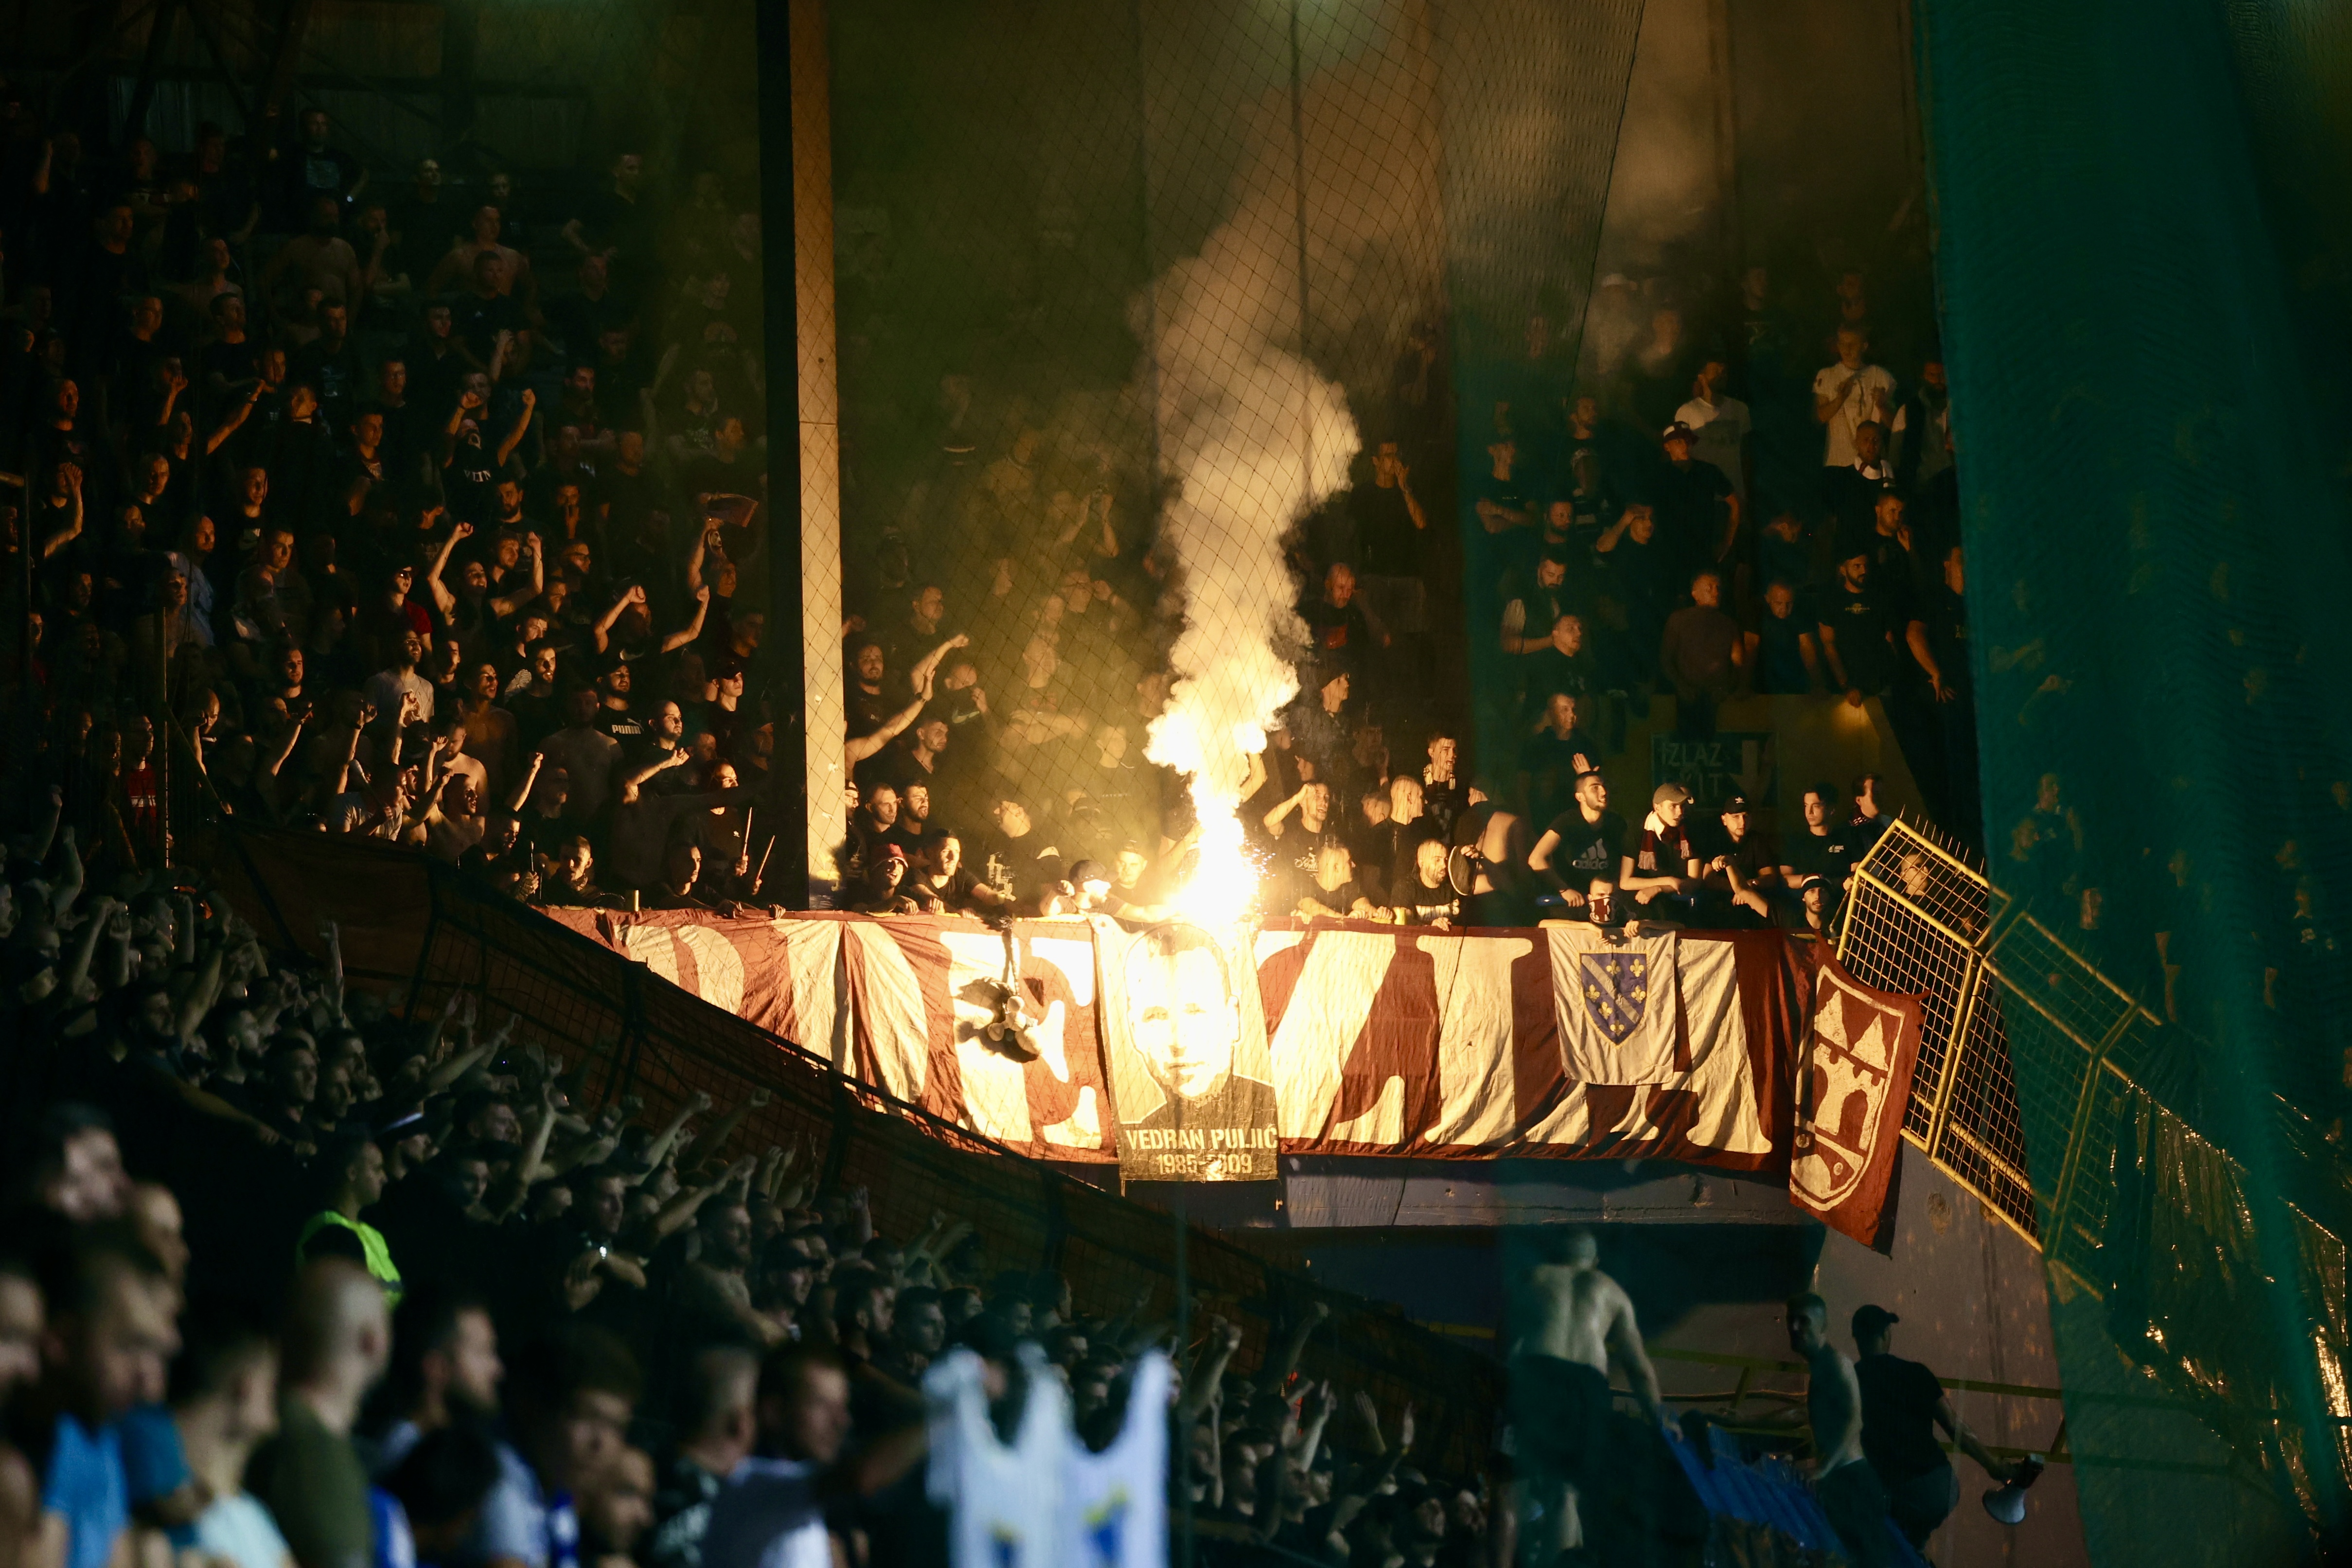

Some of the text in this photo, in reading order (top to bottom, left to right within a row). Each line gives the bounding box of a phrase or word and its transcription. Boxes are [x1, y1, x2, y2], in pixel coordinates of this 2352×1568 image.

[611, 724, 641, 735] PUMA
[1661, 742, 1723, 767] IZLAZ
[1662, 773, 1723, 801] IT
[1125, 1124, 1278, 1150] VEDRAN PULJIĆ
